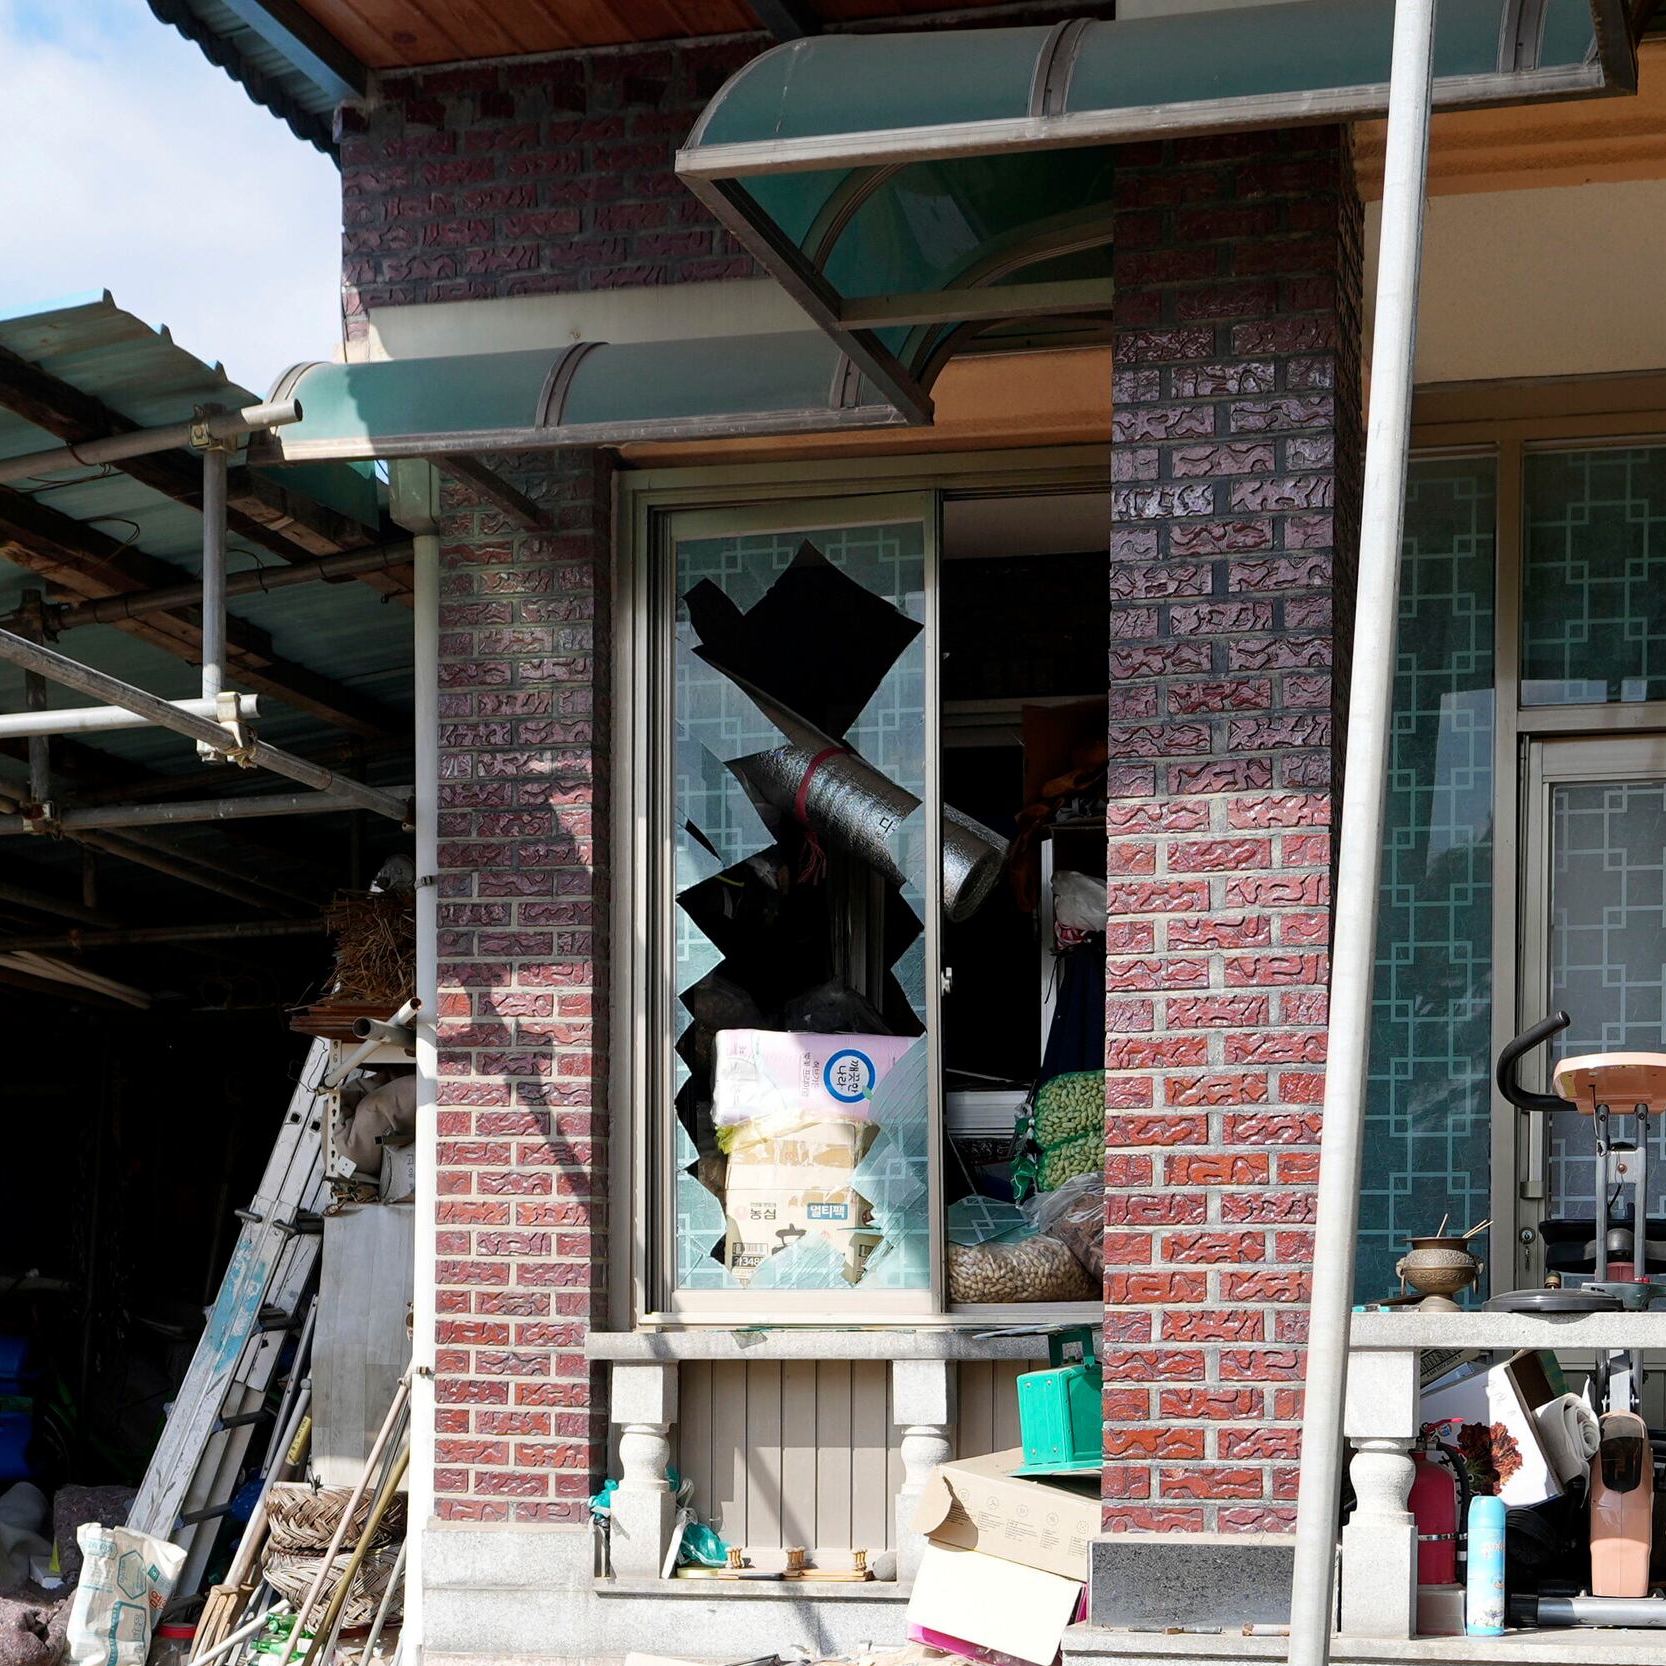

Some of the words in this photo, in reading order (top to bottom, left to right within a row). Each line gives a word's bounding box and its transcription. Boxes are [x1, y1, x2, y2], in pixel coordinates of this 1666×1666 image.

[836, 1065, 847, 1090] 나라
[847, 1059, 860, 1094] 깨끗한
[749, 1209, 777, 1221] 농심
[810, 1204, 846, 1219] 멀티팩
